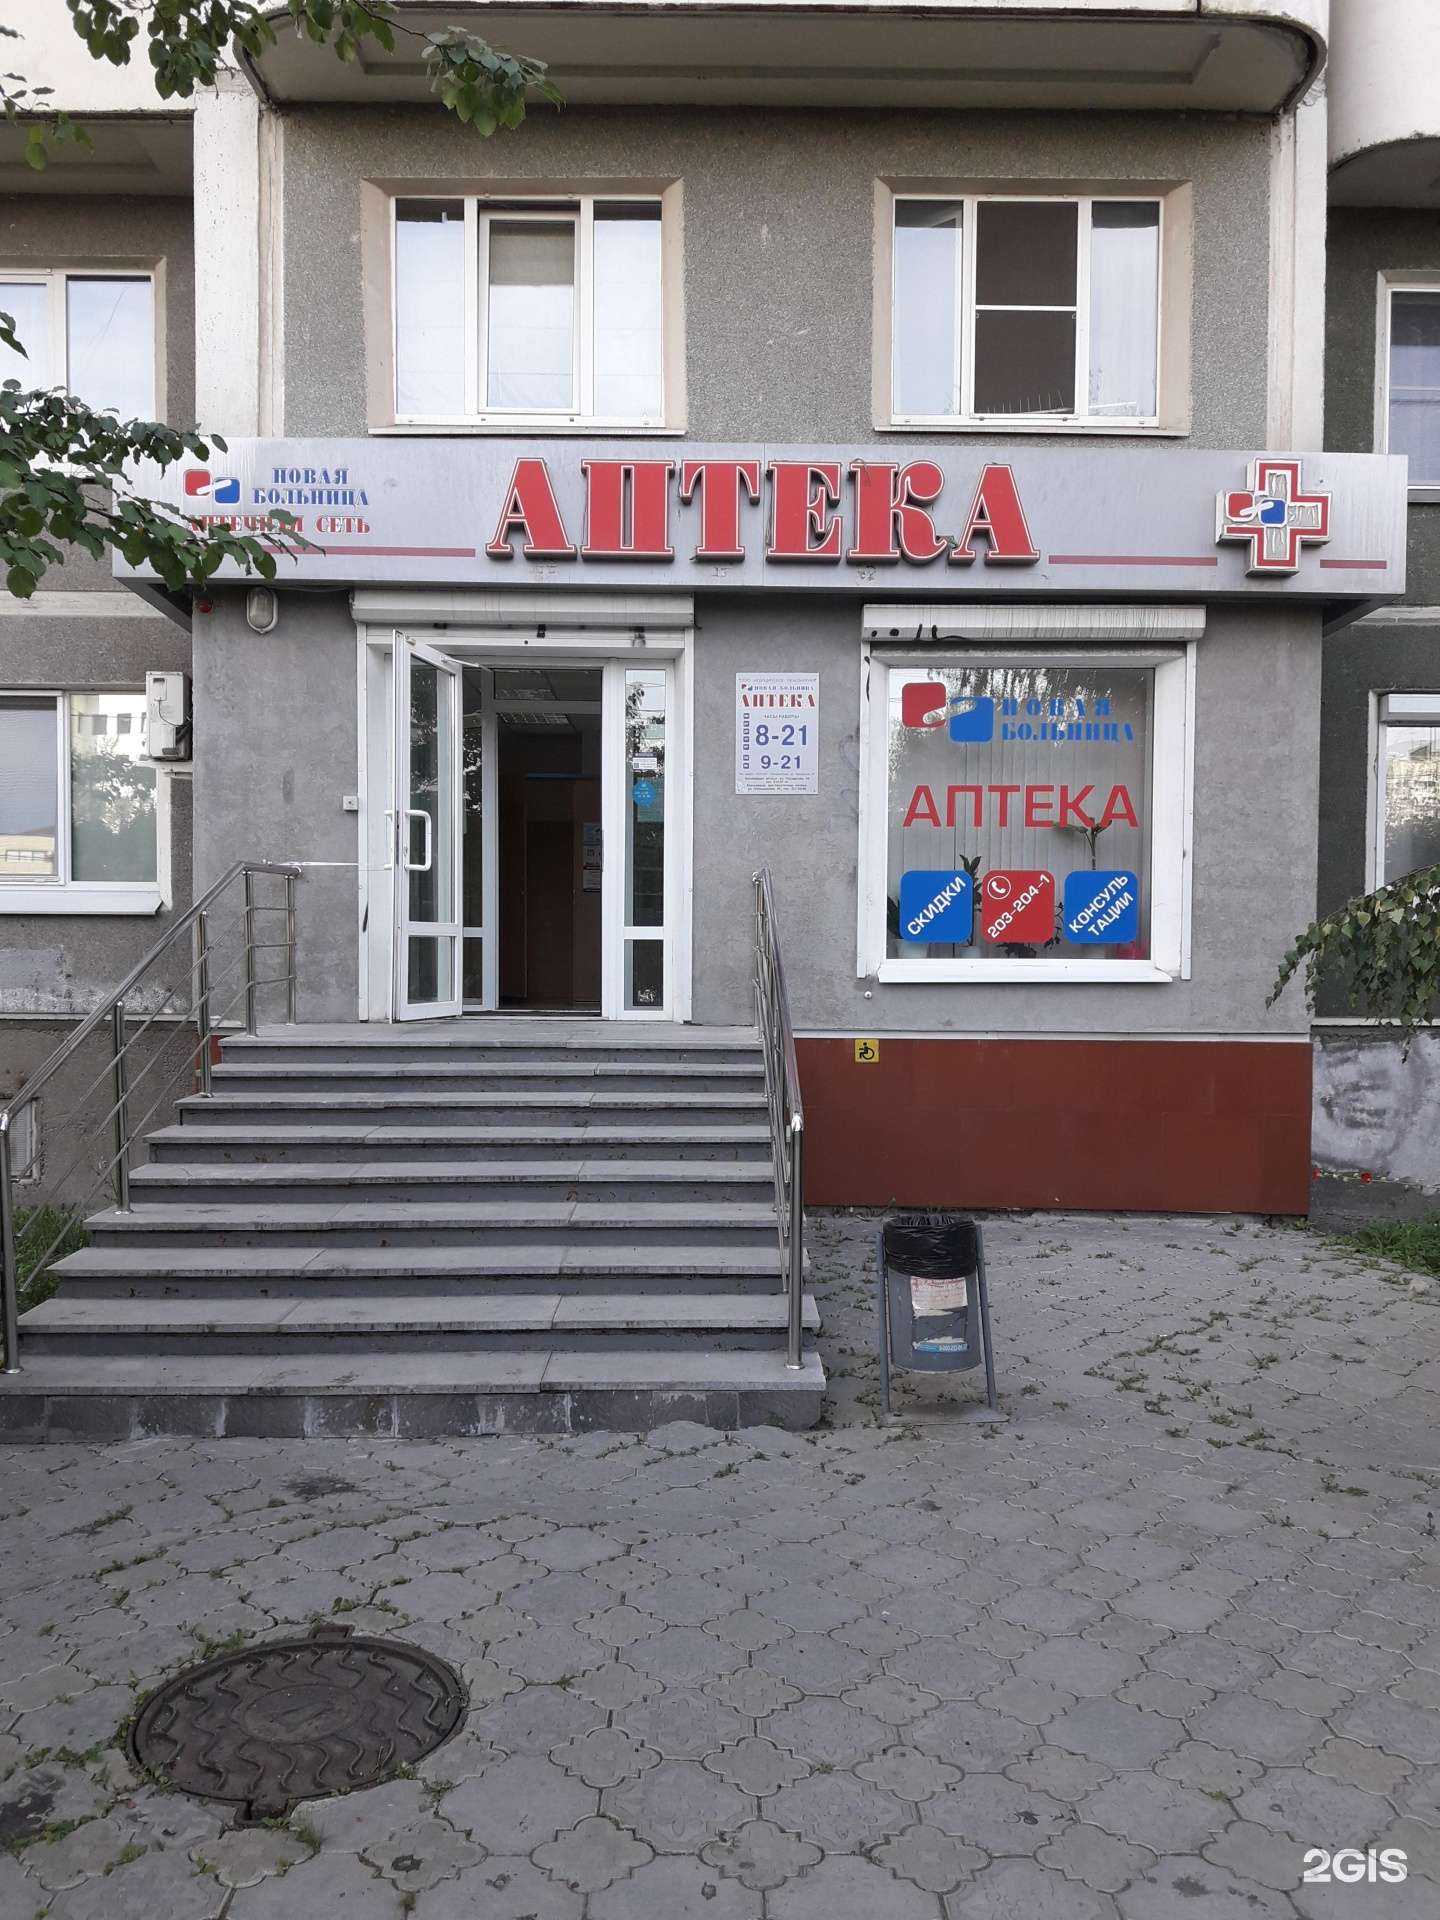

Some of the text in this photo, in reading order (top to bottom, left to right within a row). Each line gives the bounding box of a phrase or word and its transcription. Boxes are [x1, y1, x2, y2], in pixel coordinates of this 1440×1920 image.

[273, 467, 349, 485] НОВАЯ
[252, 487, 369, 507] БОЛЬНИЦА
[485, 457, 1041, 563] АПТЕКА
[315, 515, 371, 534] СЕТЬ
[741, 694, 816, 708] АПТЕКА
[1001, 697, 1111, 717] НОВАЯ
[755, 724, 807, 746] 8-21
[1001, 721, 1135, 742] БОЛЬНИЦА
[760, 755, 802, 770] 9-21
[902, 784, 1139, 828] АПТЕКА
[906, 875, 967, 936] СКИДКИ
[987, 873, 1051, 939] 203-204-1
[1068, 873, 1129, 934] КОНСУЛЬ
[1087, 891, 1135, 937] ТАЦИИ
